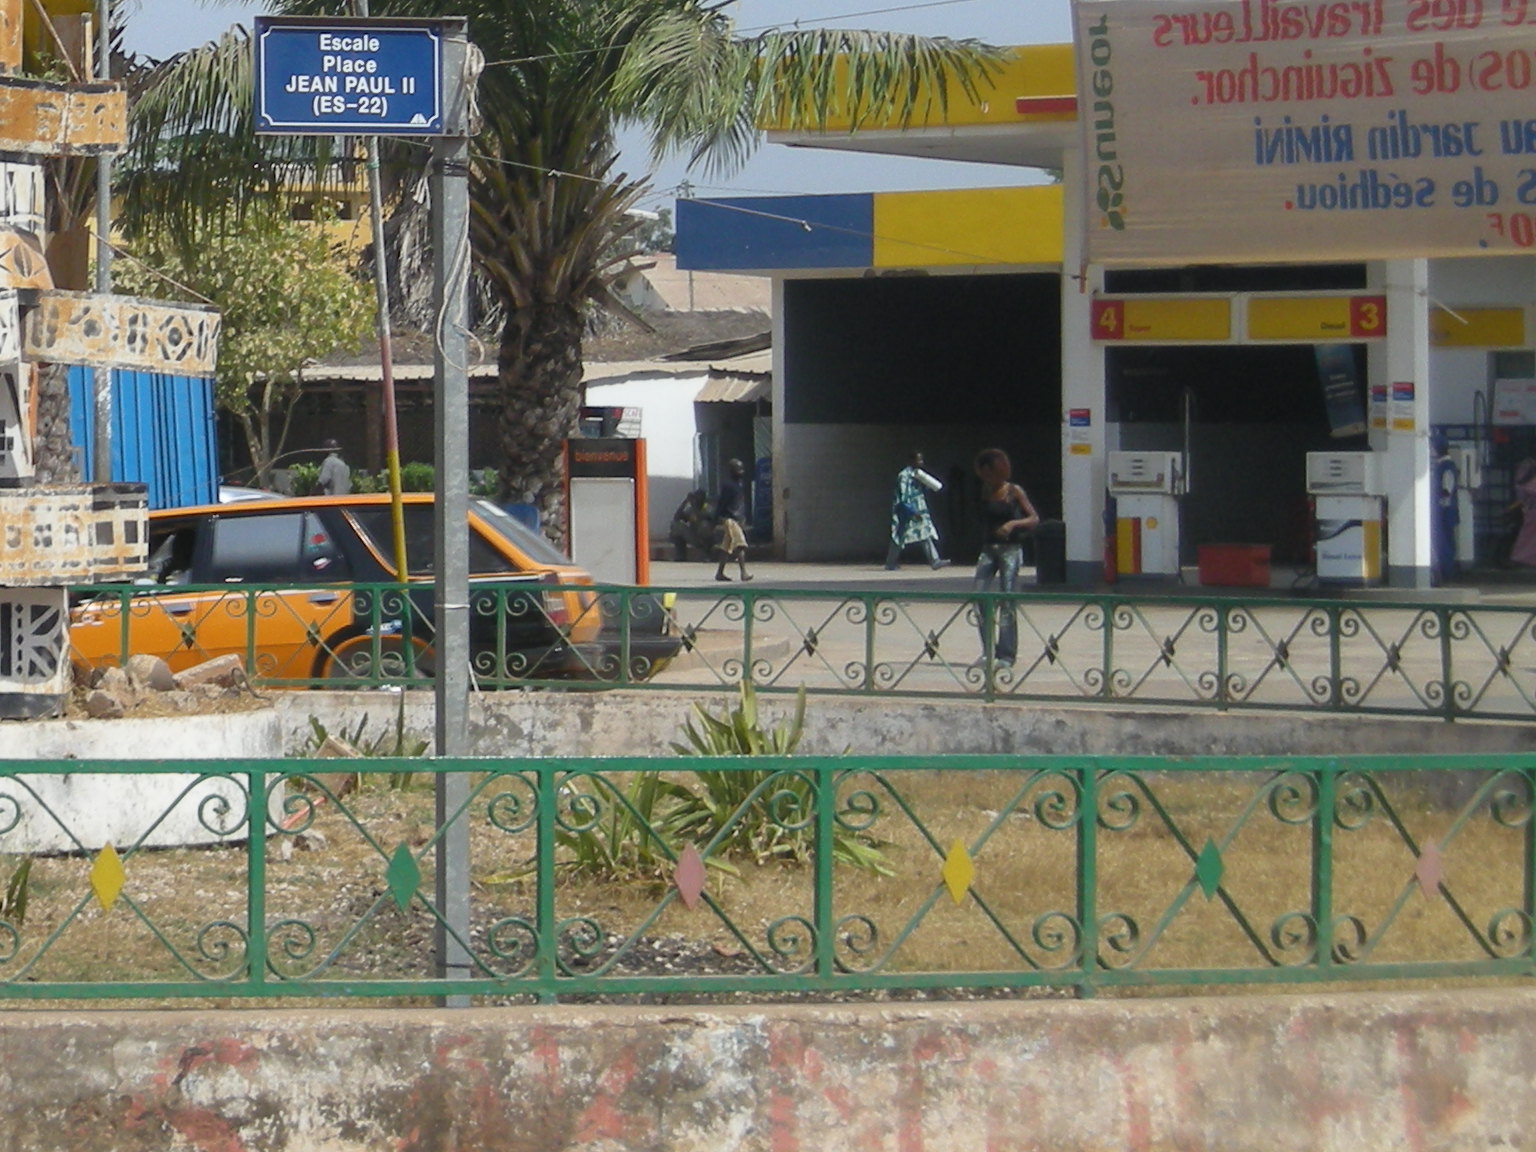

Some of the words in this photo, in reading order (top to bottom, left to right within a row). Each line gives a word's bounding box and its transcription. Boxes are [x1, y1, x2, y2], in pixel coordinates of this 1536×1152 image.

[320, 34, 380, 52] Escale
[323, 56, 377, 72] Place
[285, 76, 337, 93] JEAN
[345, 77, 395, 94] PAUL
[402, 77, 415, 94] II
[313, 96, 388, 117] (ES-22)
[1099, 307, 1117, 332] 4
[1360, 303, 1380, 330] 3
